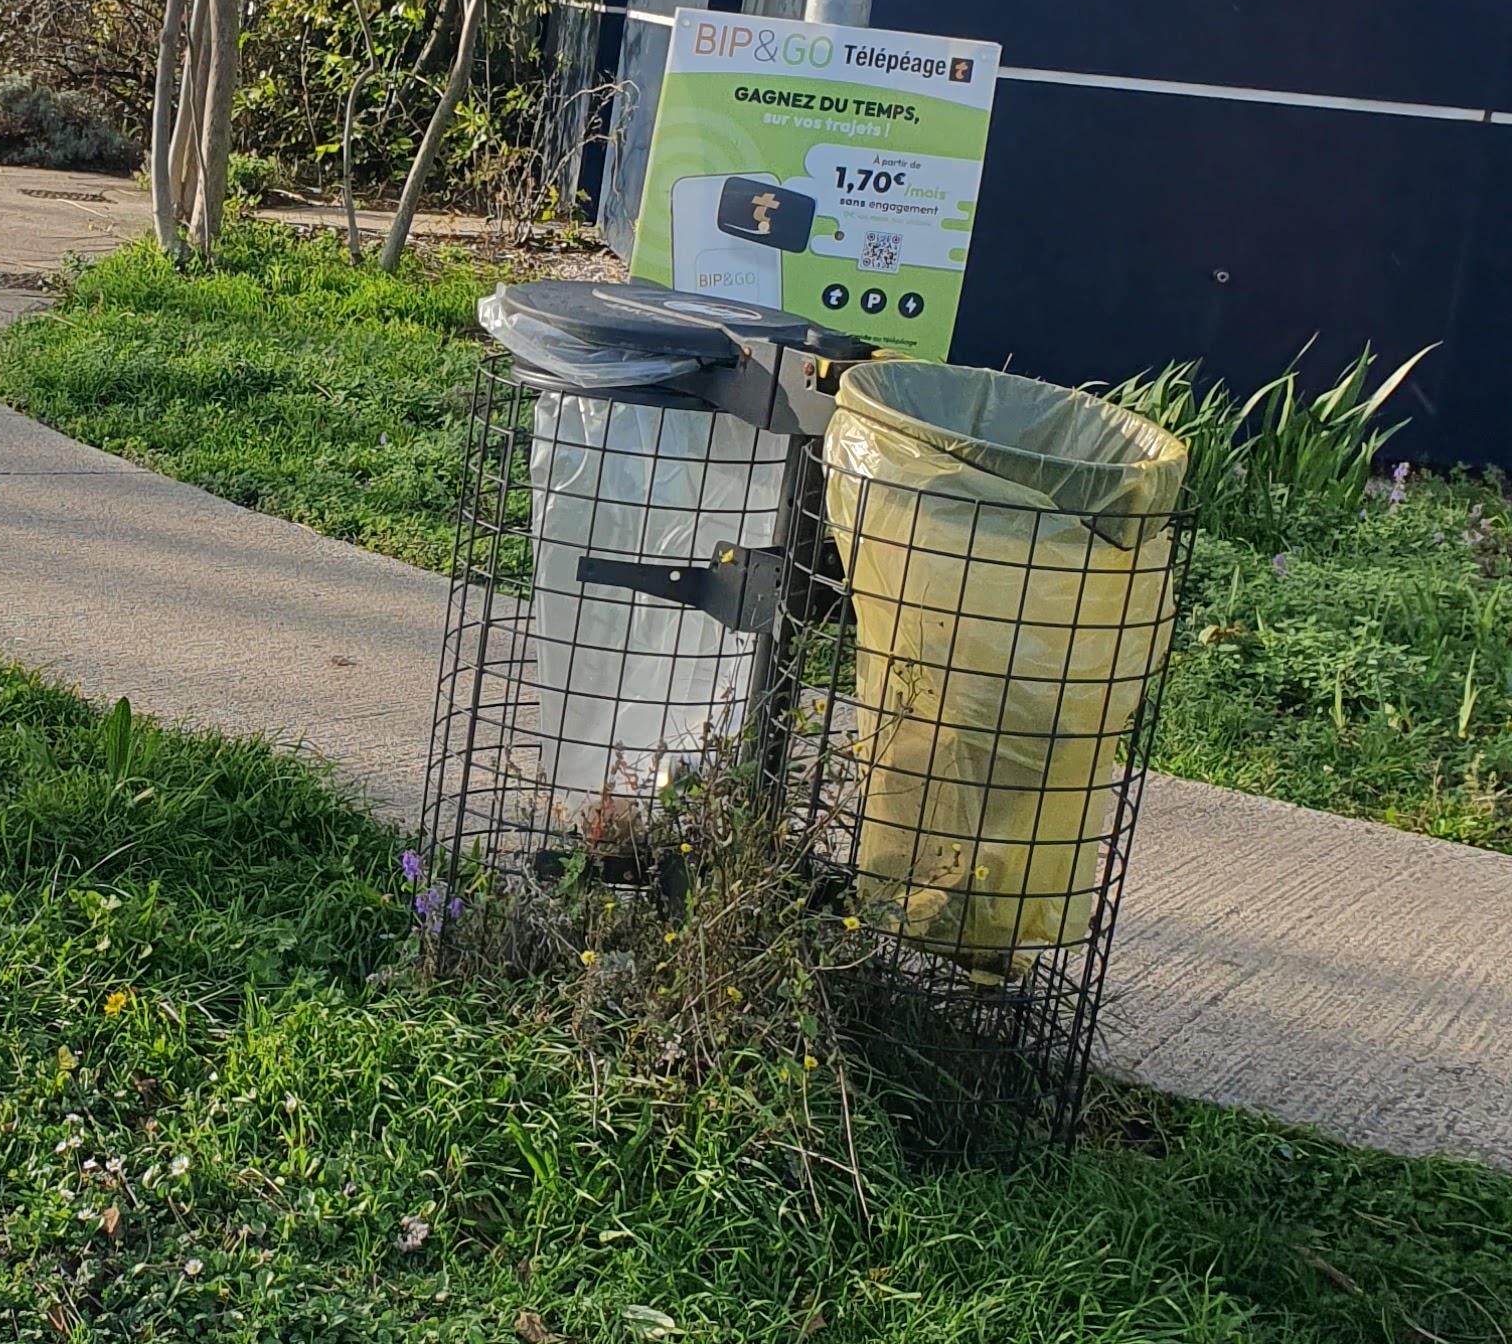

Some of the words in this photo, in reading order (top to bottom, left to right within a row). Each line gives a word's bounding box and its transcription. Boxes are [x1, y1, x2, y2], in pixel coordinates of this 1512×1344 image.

[694, 22, 834, 69] BIP&GO
[844, 44, 947, 79] Télépéage
[734, 86, 816, 111] GAGNEZ
[819, 96, 849, 113] DU
[852, 99, 920, 125] TEMPS,
[763, 112, 790, 125] sur
[793, 116, 822, 129] vos
[825, 117, 881, 137] trajets
[881, 158, 908, 168] partir
[909, 159, 922, 170] de
[839, 197, 866, 208] sans
[868, 198, 939, 216] engagement
[699, 271, 756, 288] BIP&GO
